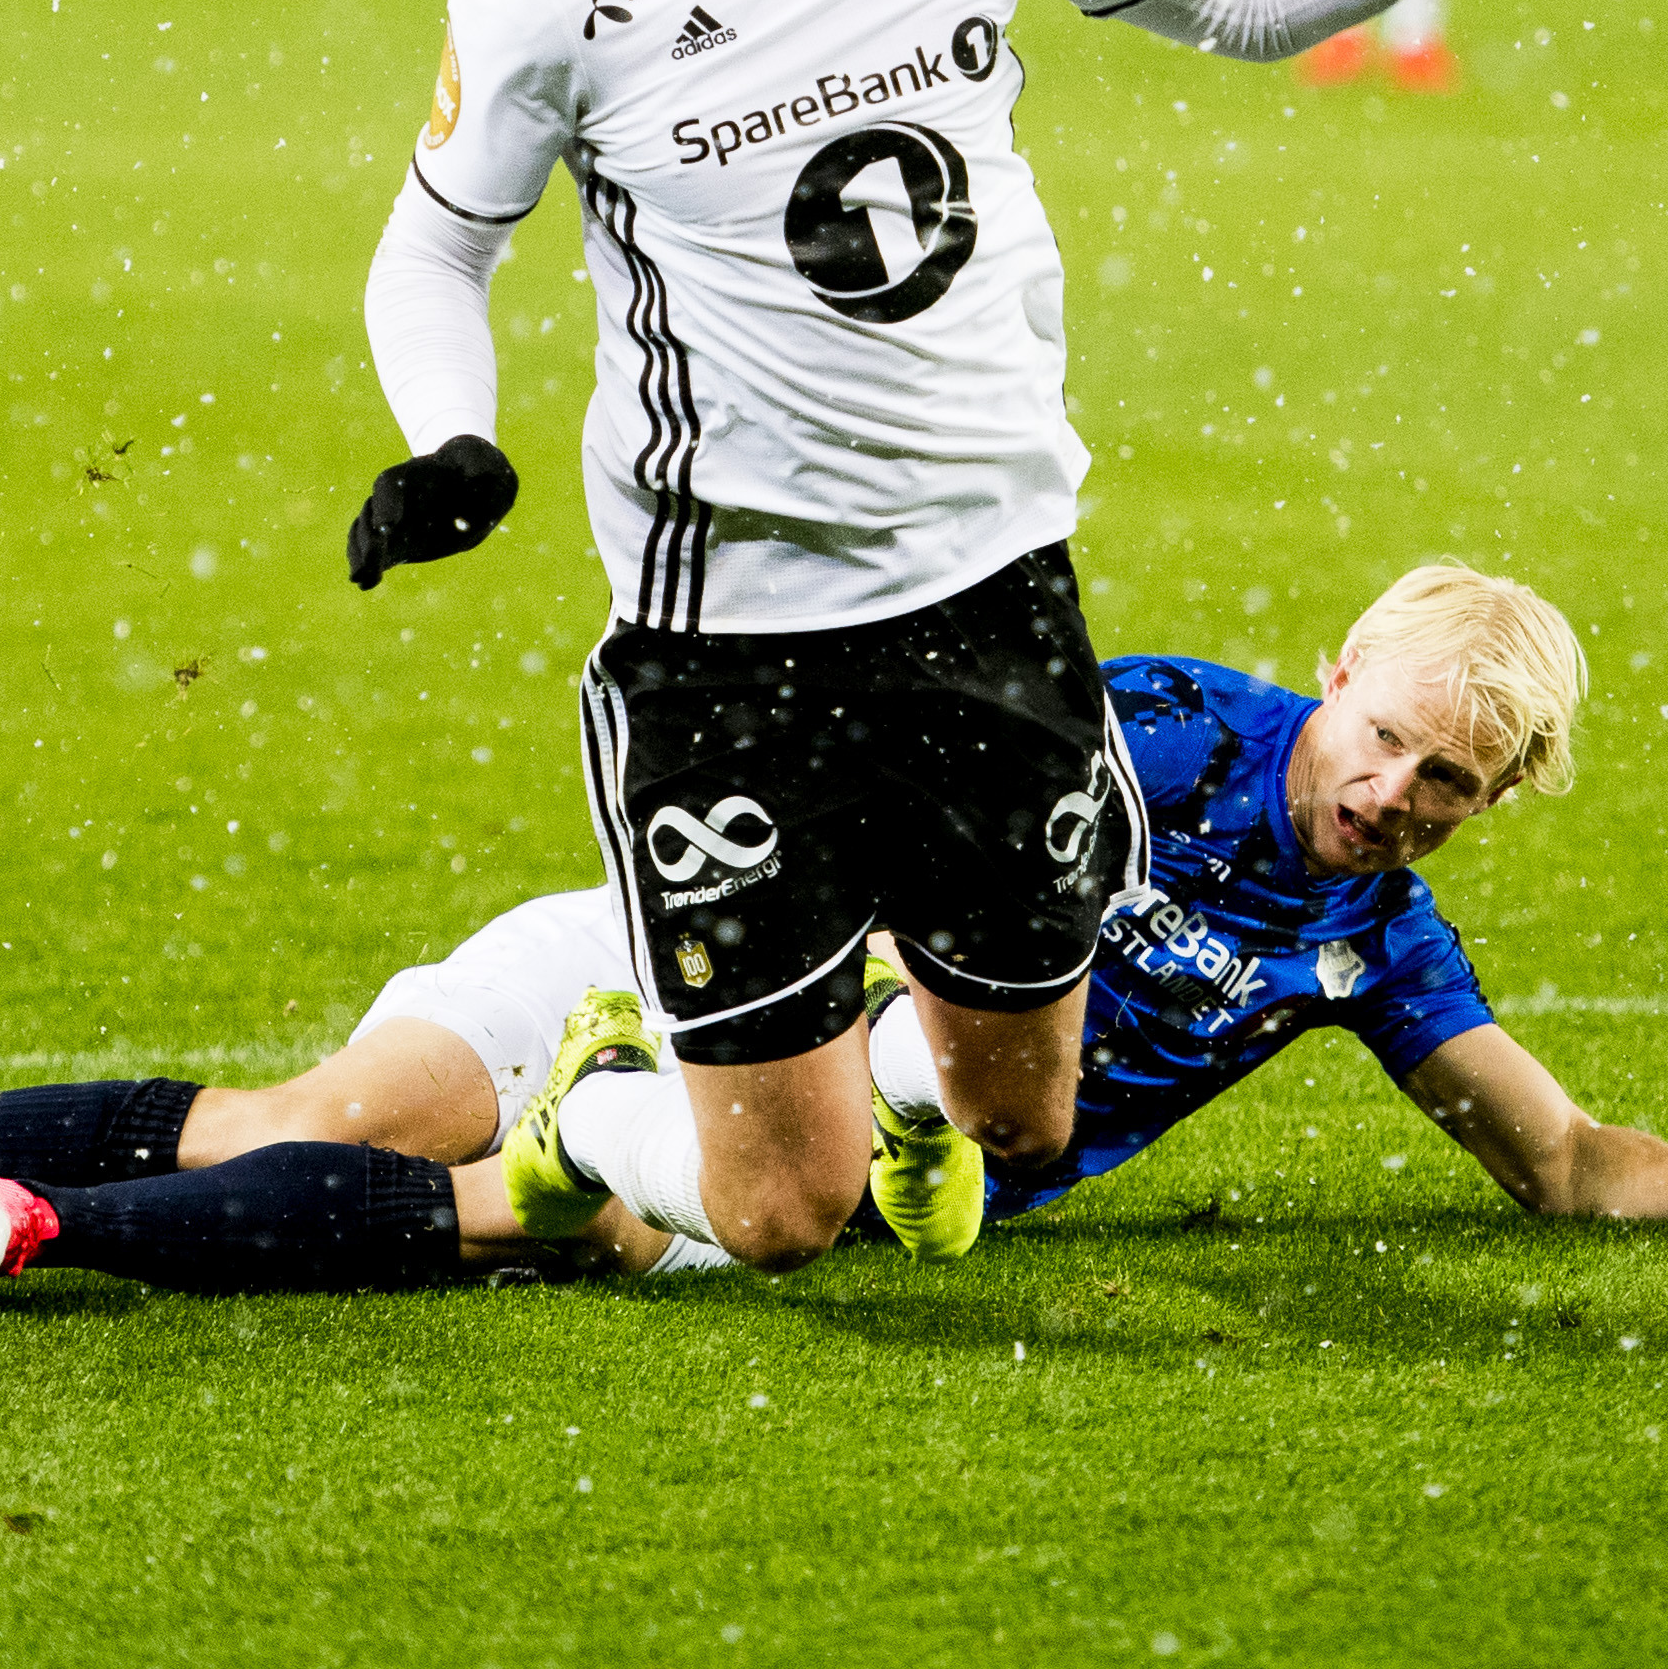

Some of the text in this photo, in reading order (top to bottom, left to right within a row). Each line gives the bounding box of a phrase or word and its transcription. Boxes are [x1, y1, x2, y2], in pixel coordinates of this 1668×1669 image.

[671, 27, 738, 60] adidas
[672, 45, 951, 166] SpareBank
[660, 852, 783, 910] TrønderEnergi
[681, 952, 707, 977] 100
[1102, 916, 1234, 1034] STLANDET
[1132, 888, 1267, 1008] reBank
